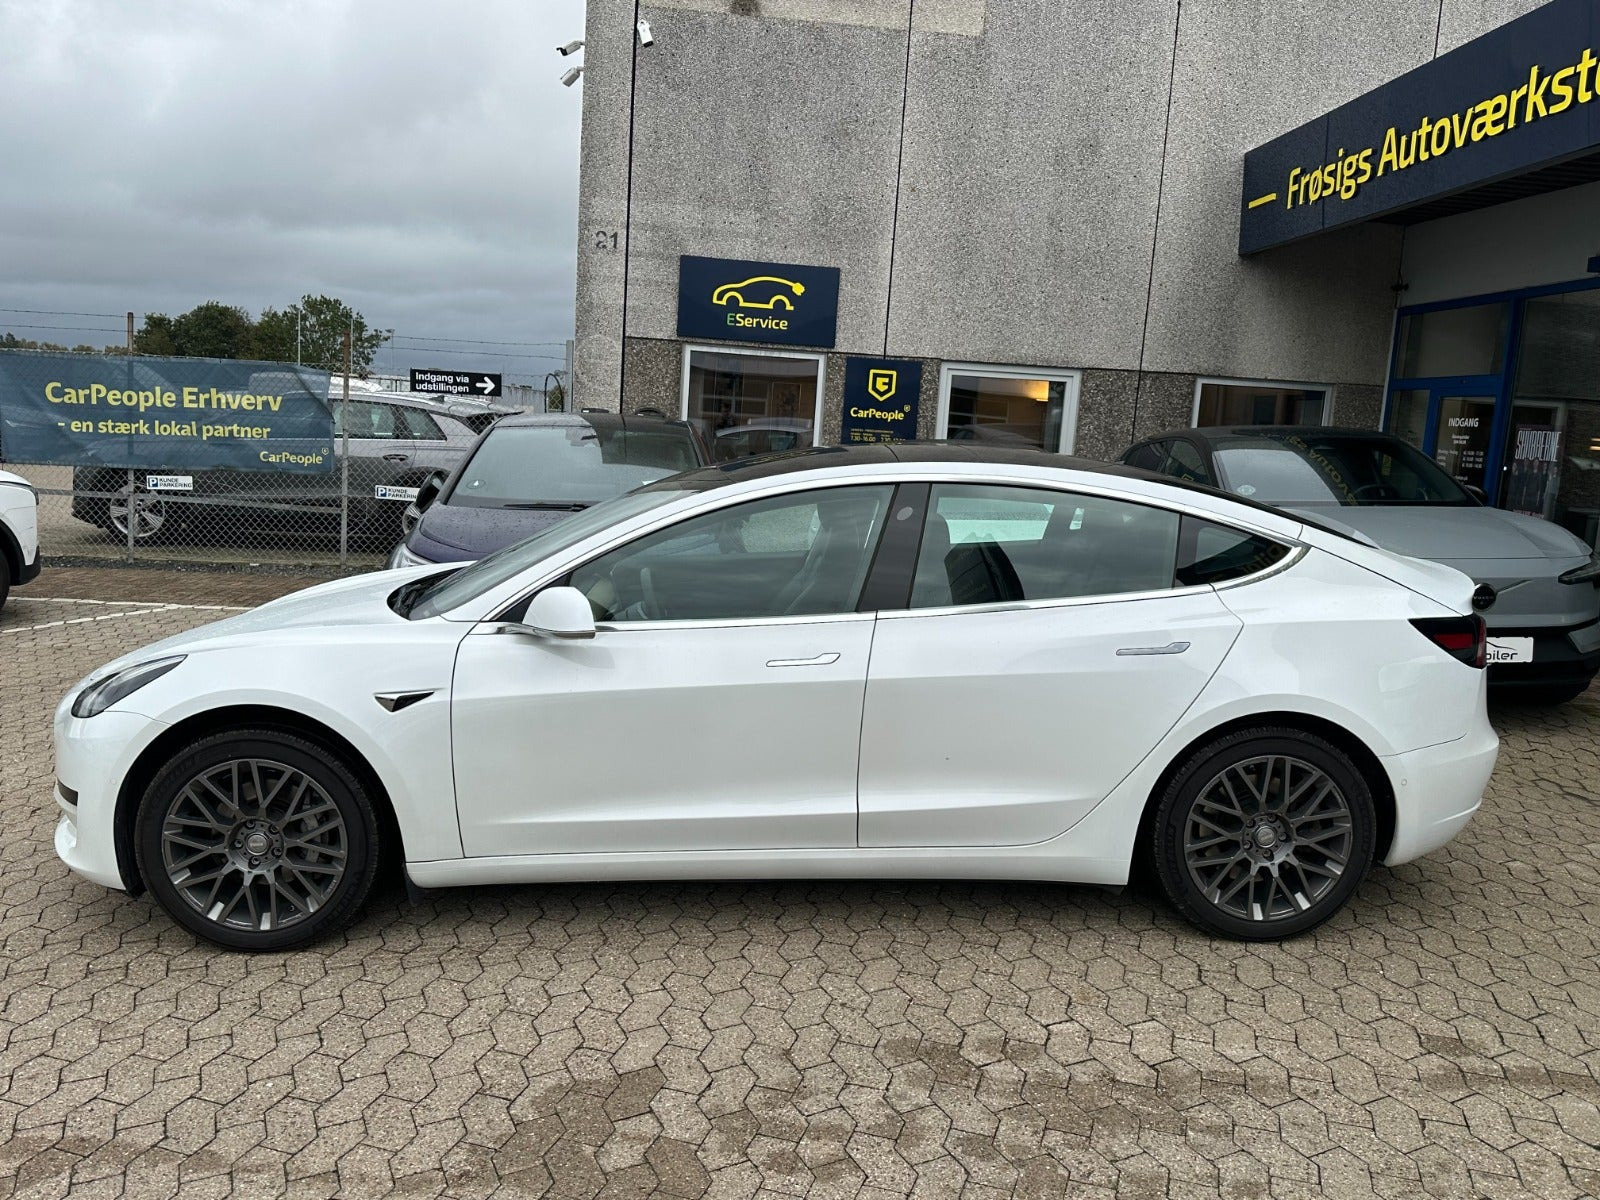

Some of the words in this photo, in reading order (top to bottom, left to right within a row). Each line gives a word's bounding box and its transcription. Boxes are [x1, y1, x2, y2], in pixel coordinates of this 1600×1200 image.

[1286, 148, 1373, 209] Frøsigs
[1377, 48, 1600, 177] Autoværkst
[595, 230, 618, 250] 21
[727, 313, 788, 330] EService
[415, 372, 454, 384] Indgang
[455, 374, 470, 383] via
[415, 382, 470, 394] udstillingen
[45, 381, 177, 412] CarPeople
[182, 387, 283, 411] Erhverv
[850, 407, 905, 422] CarPeople
[1447, 417, 1480, 428] INDGANG
[70, 419, 93, 433] en
[98, 419, 150, 436] stærk
[154, 420, 198, 437] lokal
[202, 423, 271, 440] partner
[259, 450, 323, 465] CarPeople
